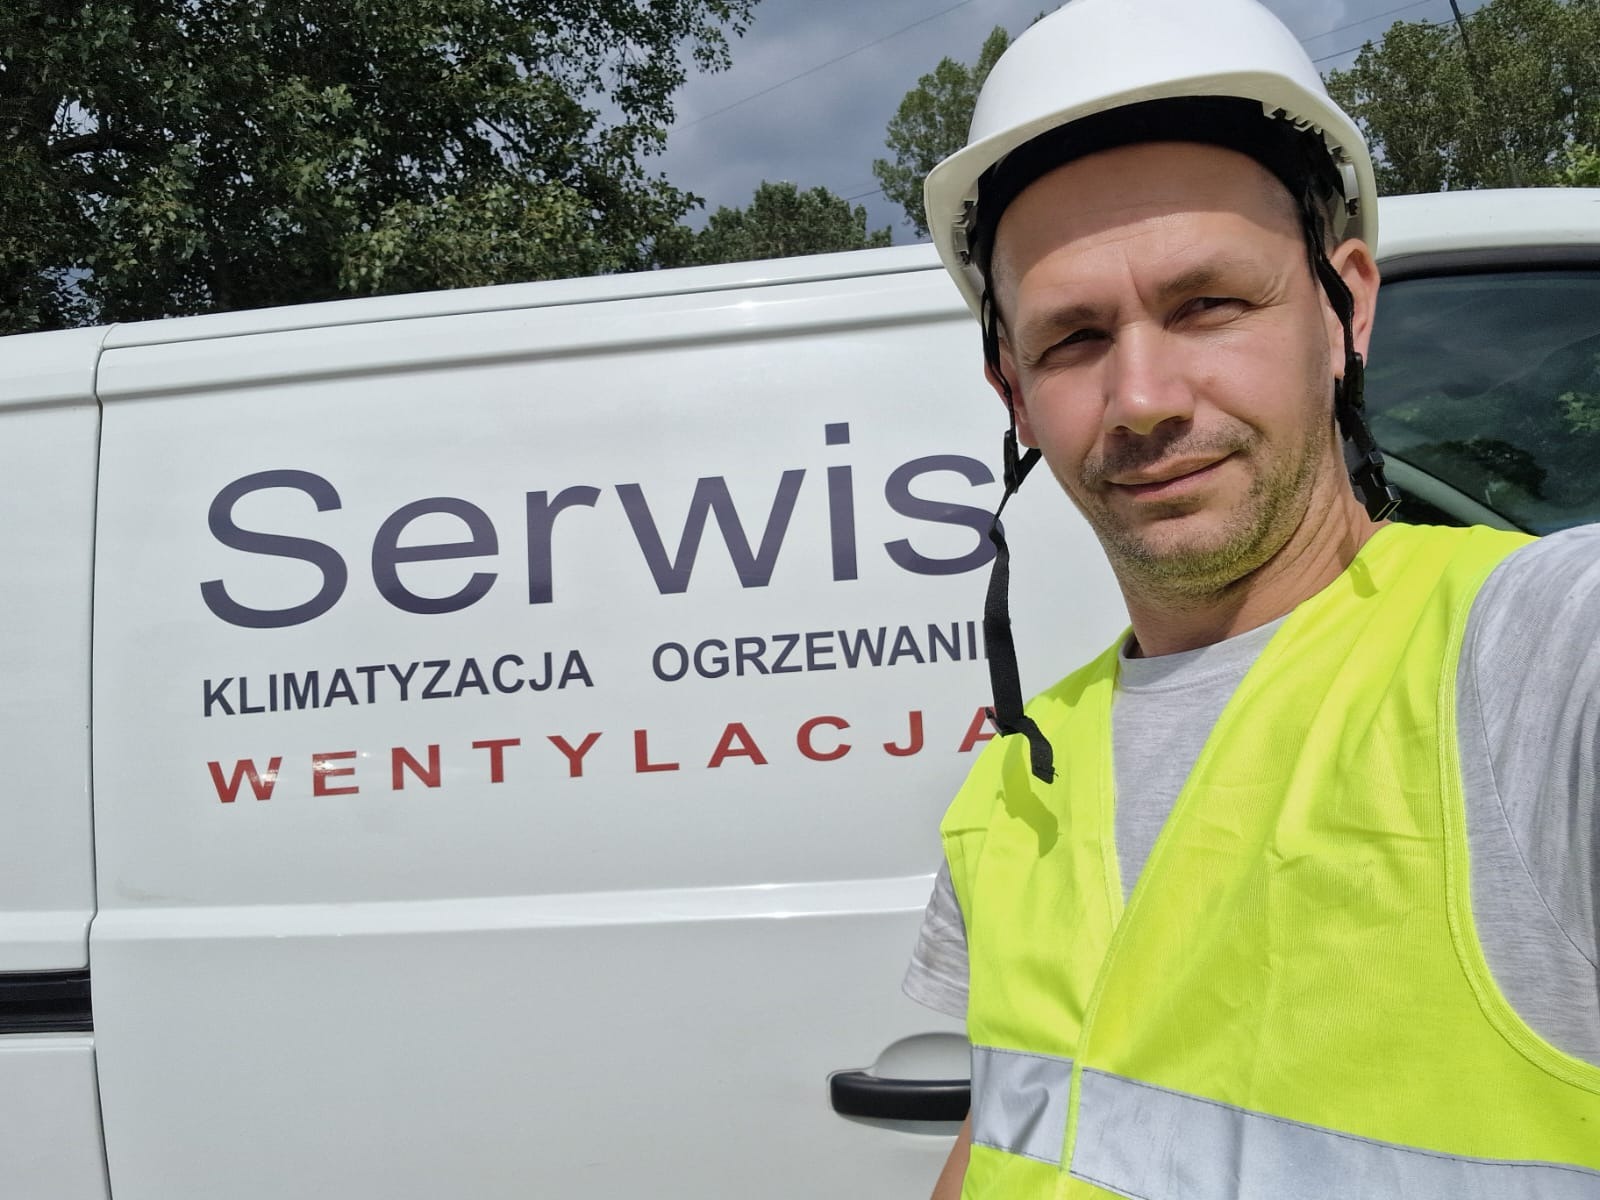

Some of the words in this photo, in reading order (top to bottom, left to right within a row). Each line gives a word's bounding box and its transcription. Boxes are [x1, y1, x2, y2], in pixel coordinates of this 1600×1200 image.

[200, 422, 1005, 628] Serwis
[203, 650, 594, 717] KLIMATYZACJA
[652, 620, 989, 682] OGRZEWANI
